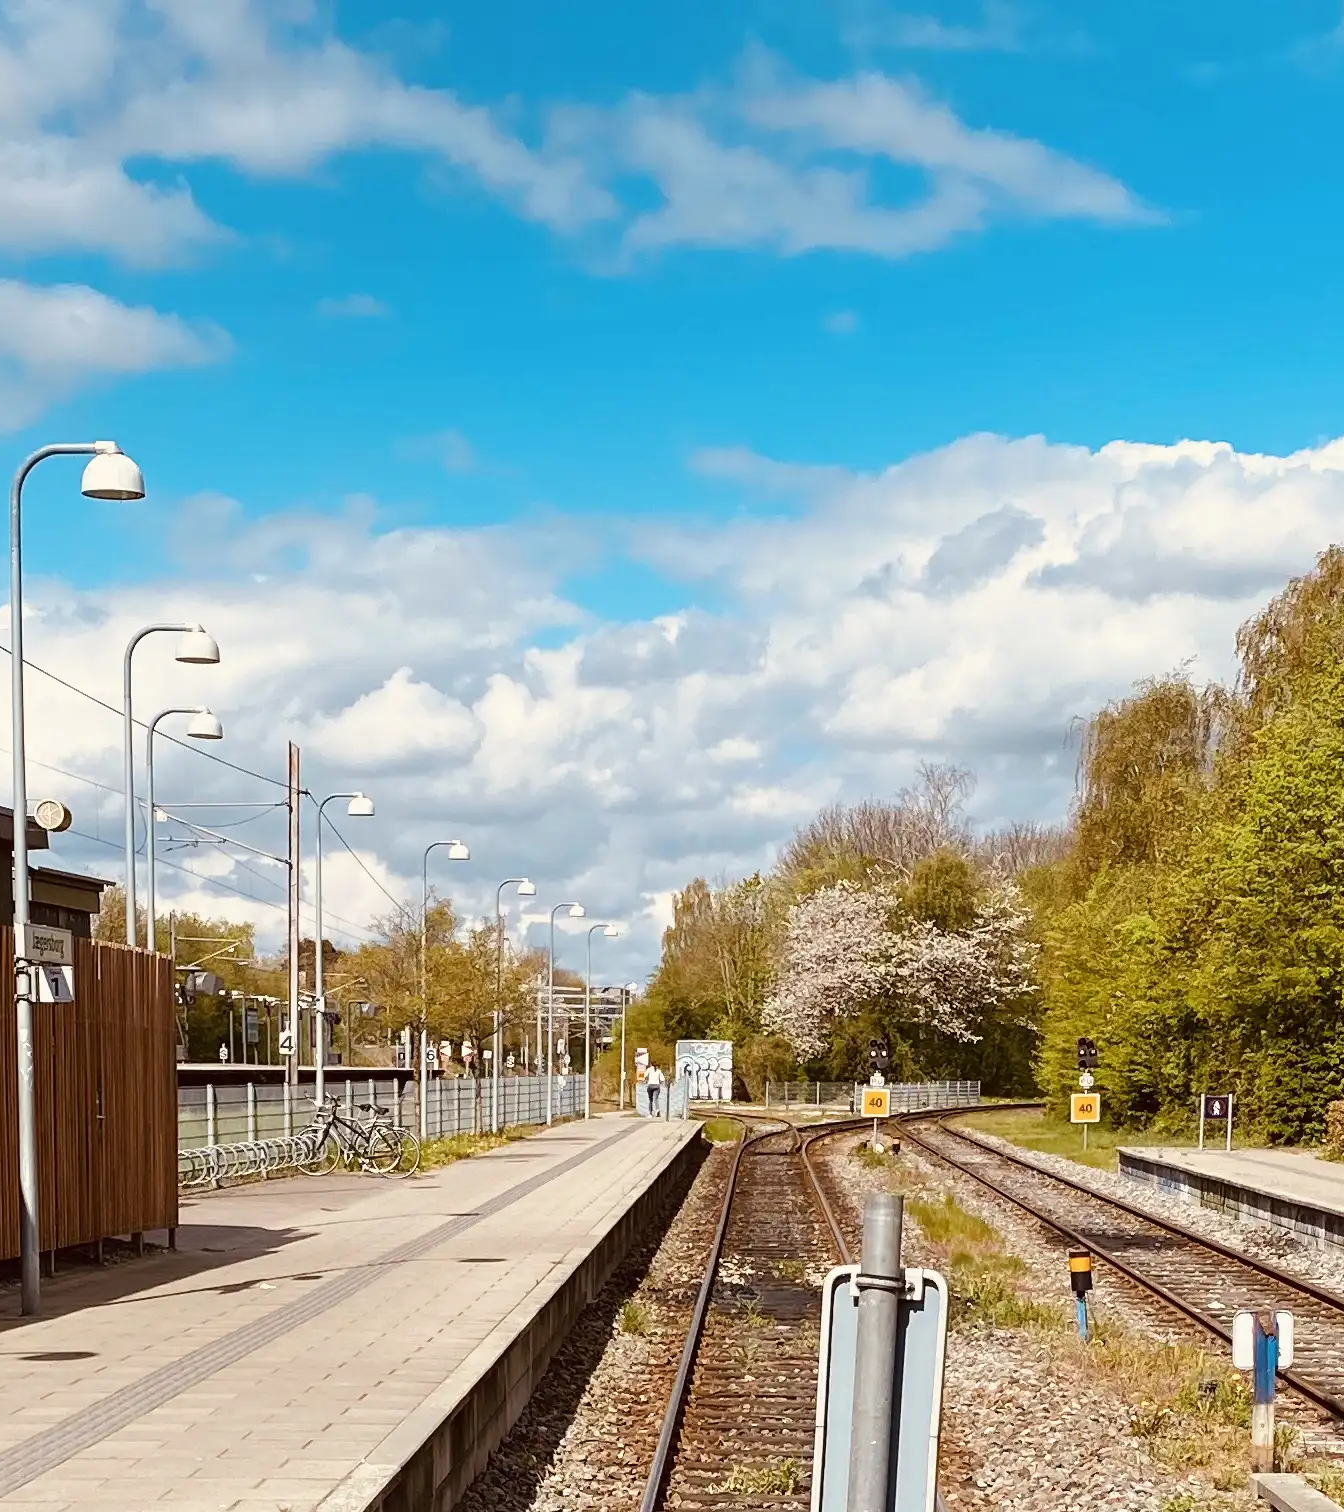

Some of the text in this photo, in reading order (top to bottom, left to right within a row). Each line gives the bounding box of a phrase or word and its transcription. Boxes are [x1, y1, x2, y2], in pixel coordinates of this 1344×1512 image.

[51, 977, 60, 997] 1
[280, 1035, 294, 1052] 4
[426, 1049, 435, 1061] 6
[869, 1097, 883, 1108] 40
[1078, 1103, 1093, 1114] 40
